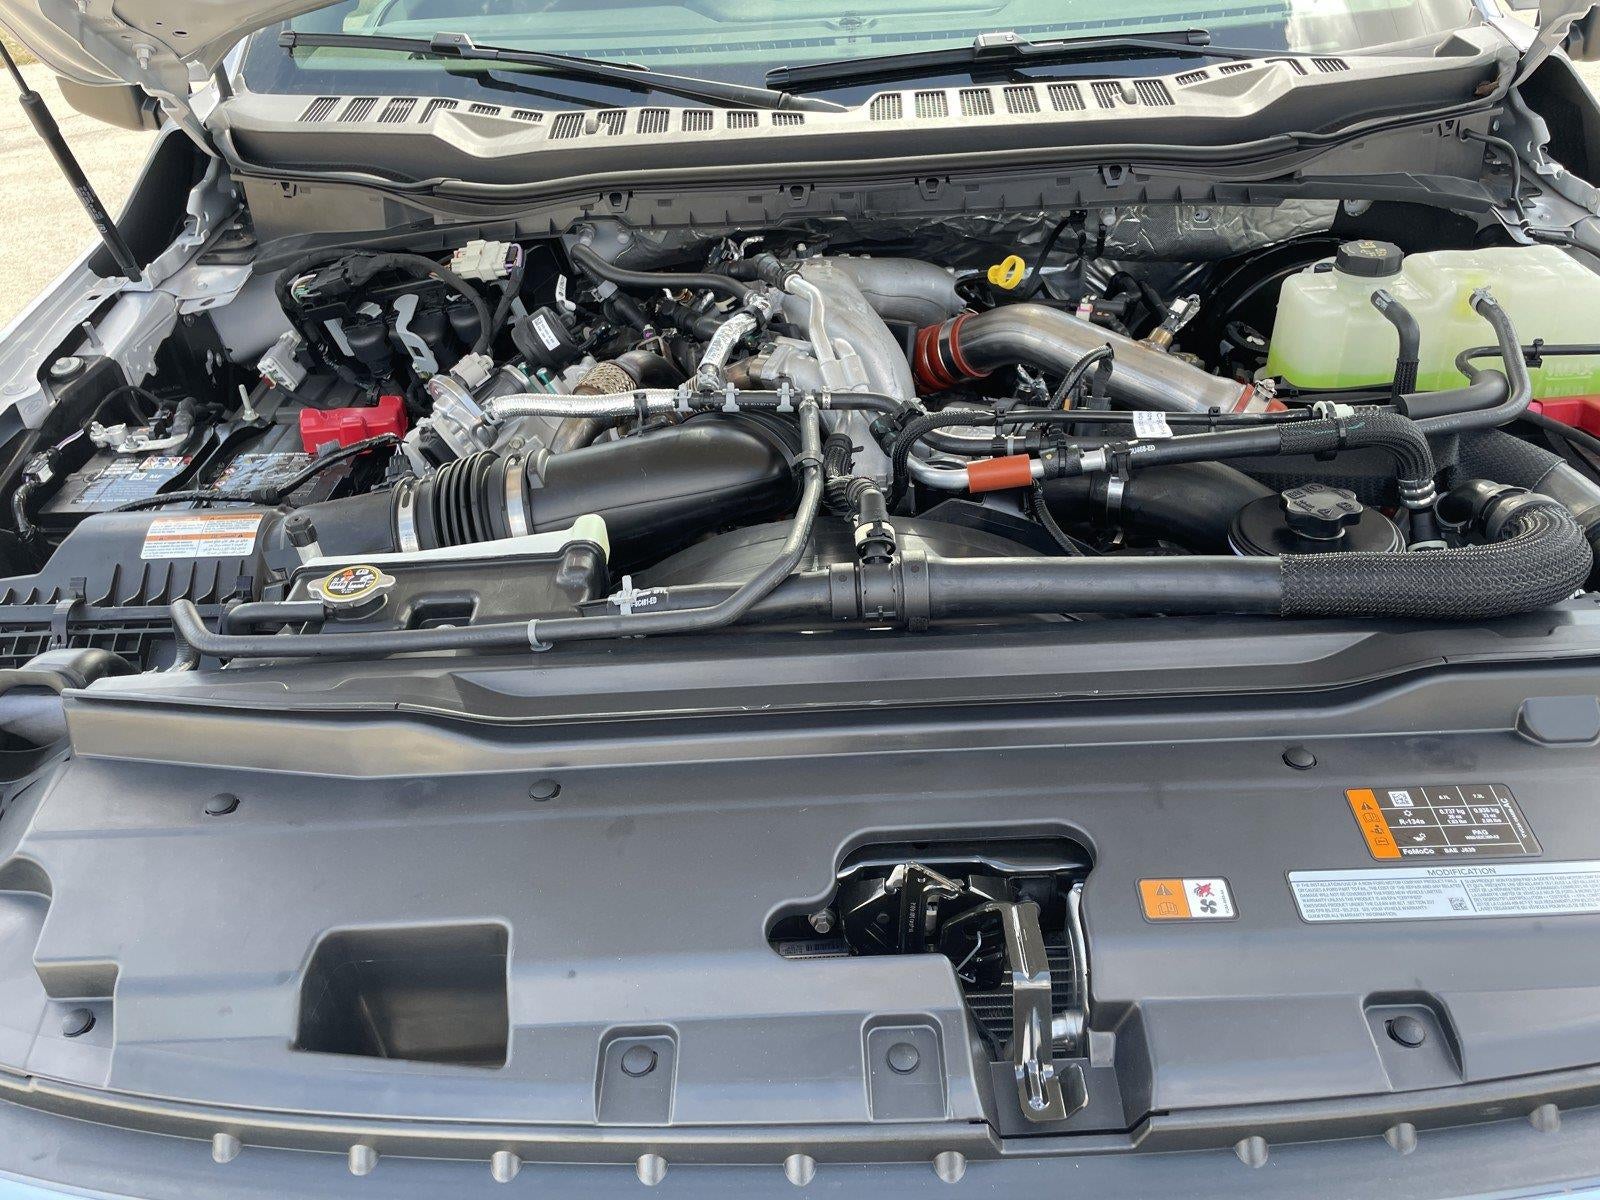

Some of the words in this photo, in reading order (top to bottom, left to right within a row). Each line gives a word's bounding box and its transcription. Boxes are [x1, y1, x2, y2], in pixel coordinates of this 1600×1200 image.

[1398, 818, 1426, 826] R-134a
[1402, 847, 1435, 855] FoMoCo
[1427, 867, 1497, 877] MODIFICATION
